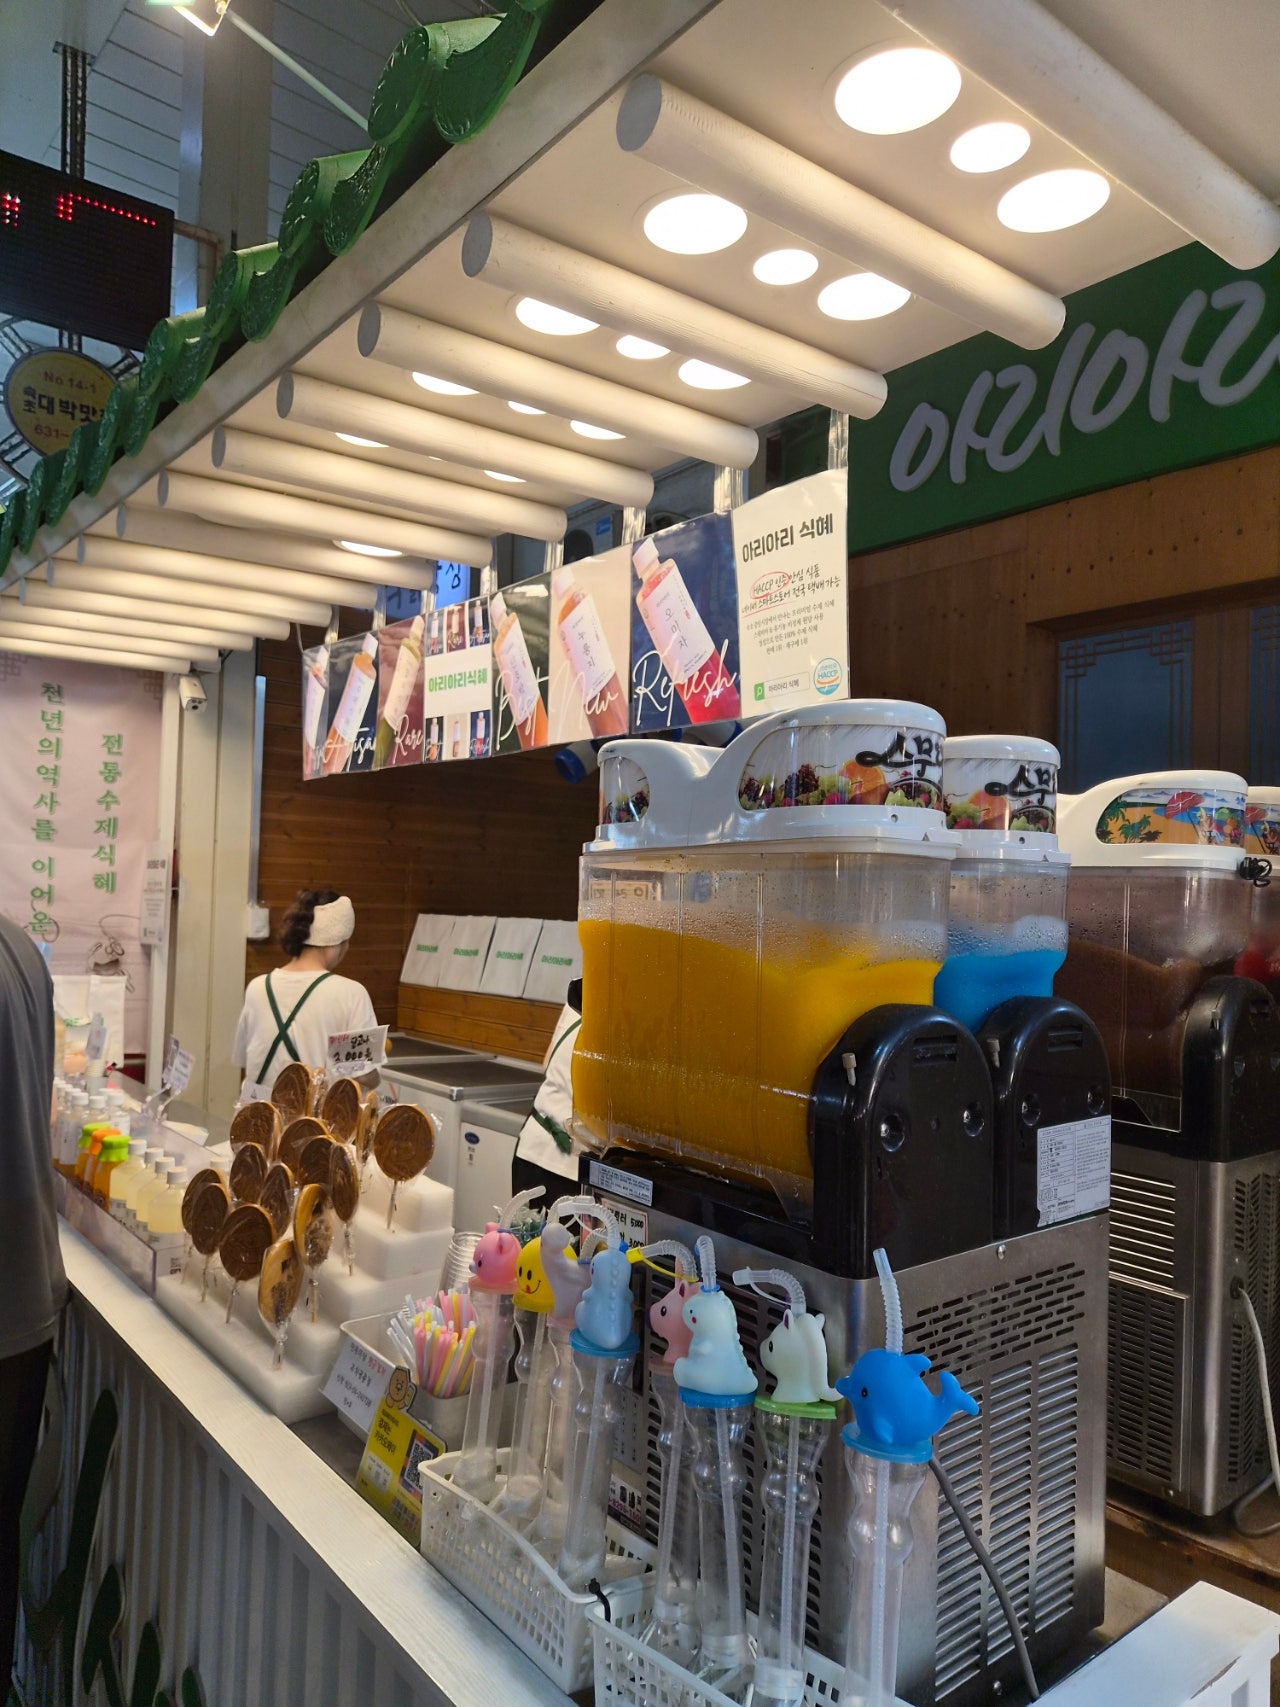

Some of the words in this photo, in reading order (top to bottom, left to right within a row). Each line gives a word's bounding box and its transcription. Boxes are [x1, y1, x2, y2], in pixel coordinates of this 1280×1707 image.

[37, 393, 105, 422] 대박맛
[742, 525, 794, 562] 아리아리
[799, 513, 833, 539] 식혜
[753, 579, 774, 595] HACCP
[789, 568, 804, 584] 안심
[806, 563, 821, 579] 식품
[793, 583, 806, 598] 전국
[825, 575, 841, 588] 가능
[664, 607, 689, 650] 오미자
[428, 667, 488, 692] 아리아리식혜
[818, 669, 839, 680] HACCP
[27, 856, 54, 935] 이어온
